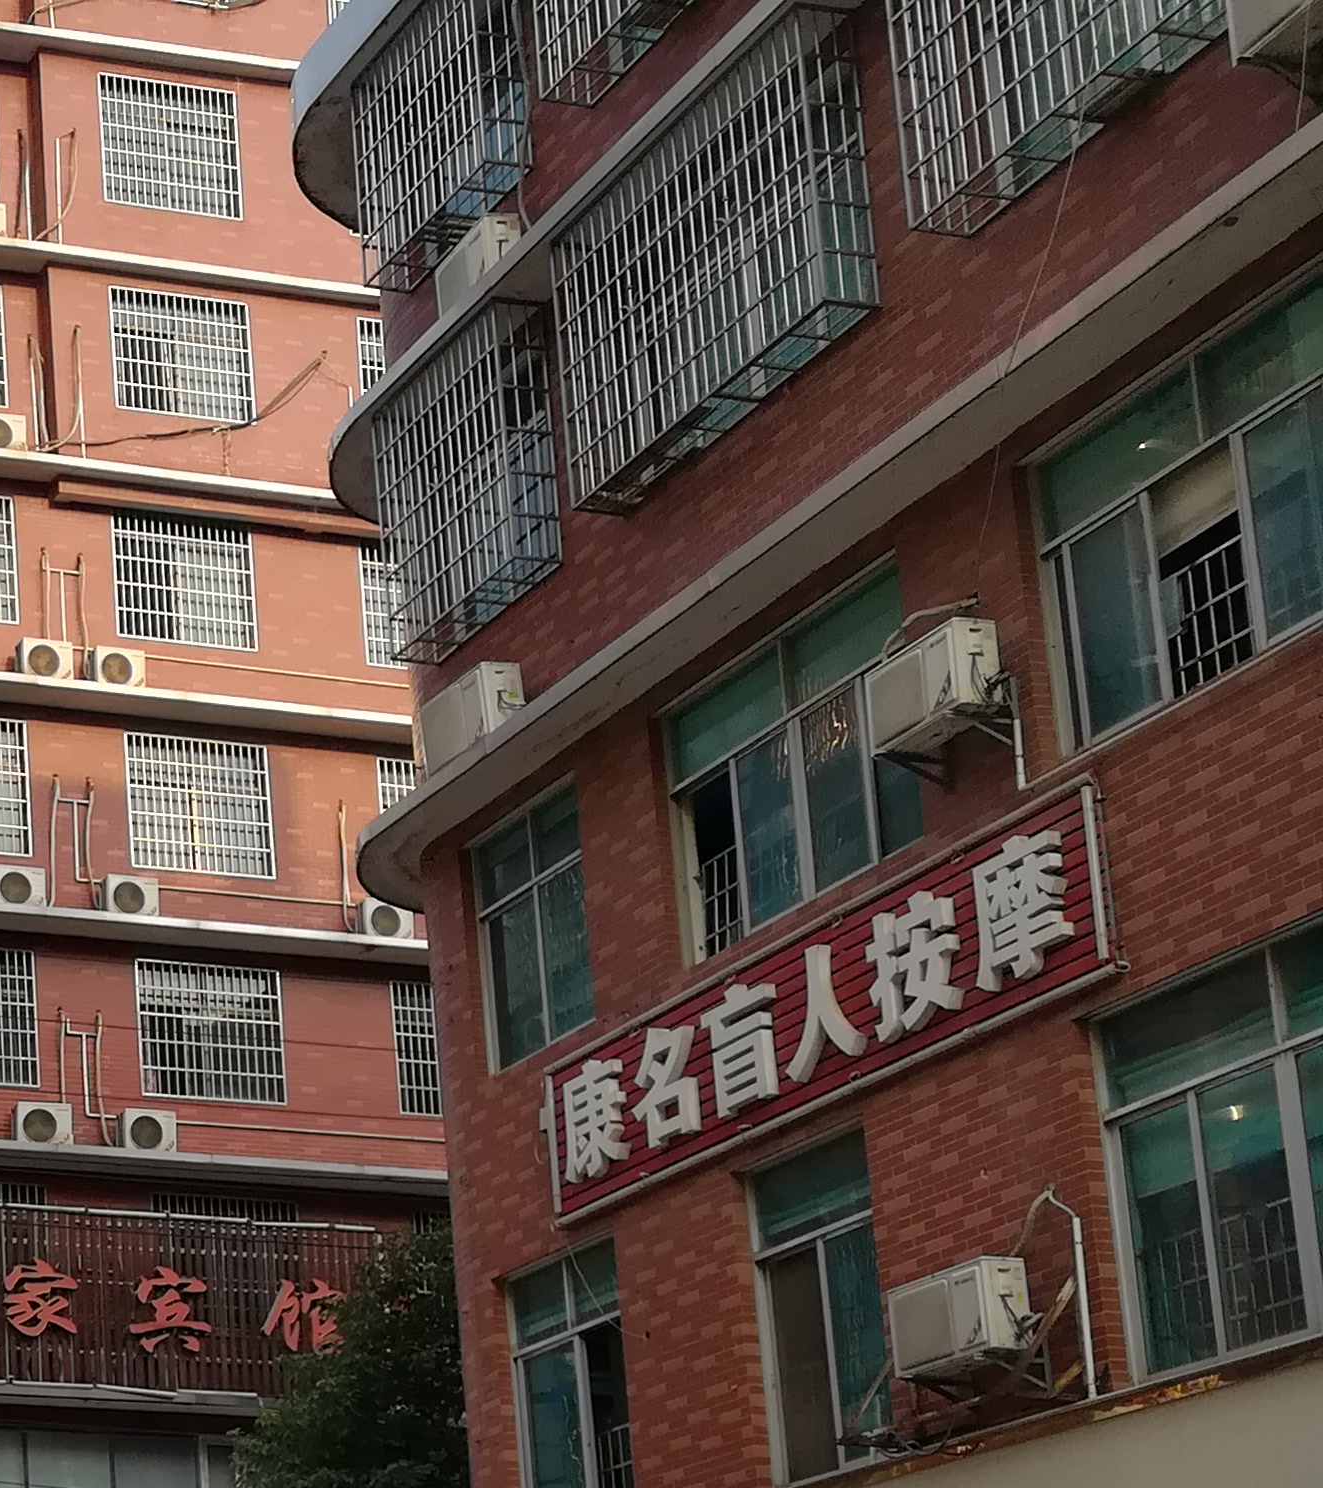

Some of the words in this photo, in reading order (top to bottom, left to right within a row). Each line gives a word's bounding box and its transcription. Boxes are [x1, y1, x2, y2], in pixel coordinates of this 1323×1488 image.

[562, 829, 1075, 1184] 康名盲人按摩
